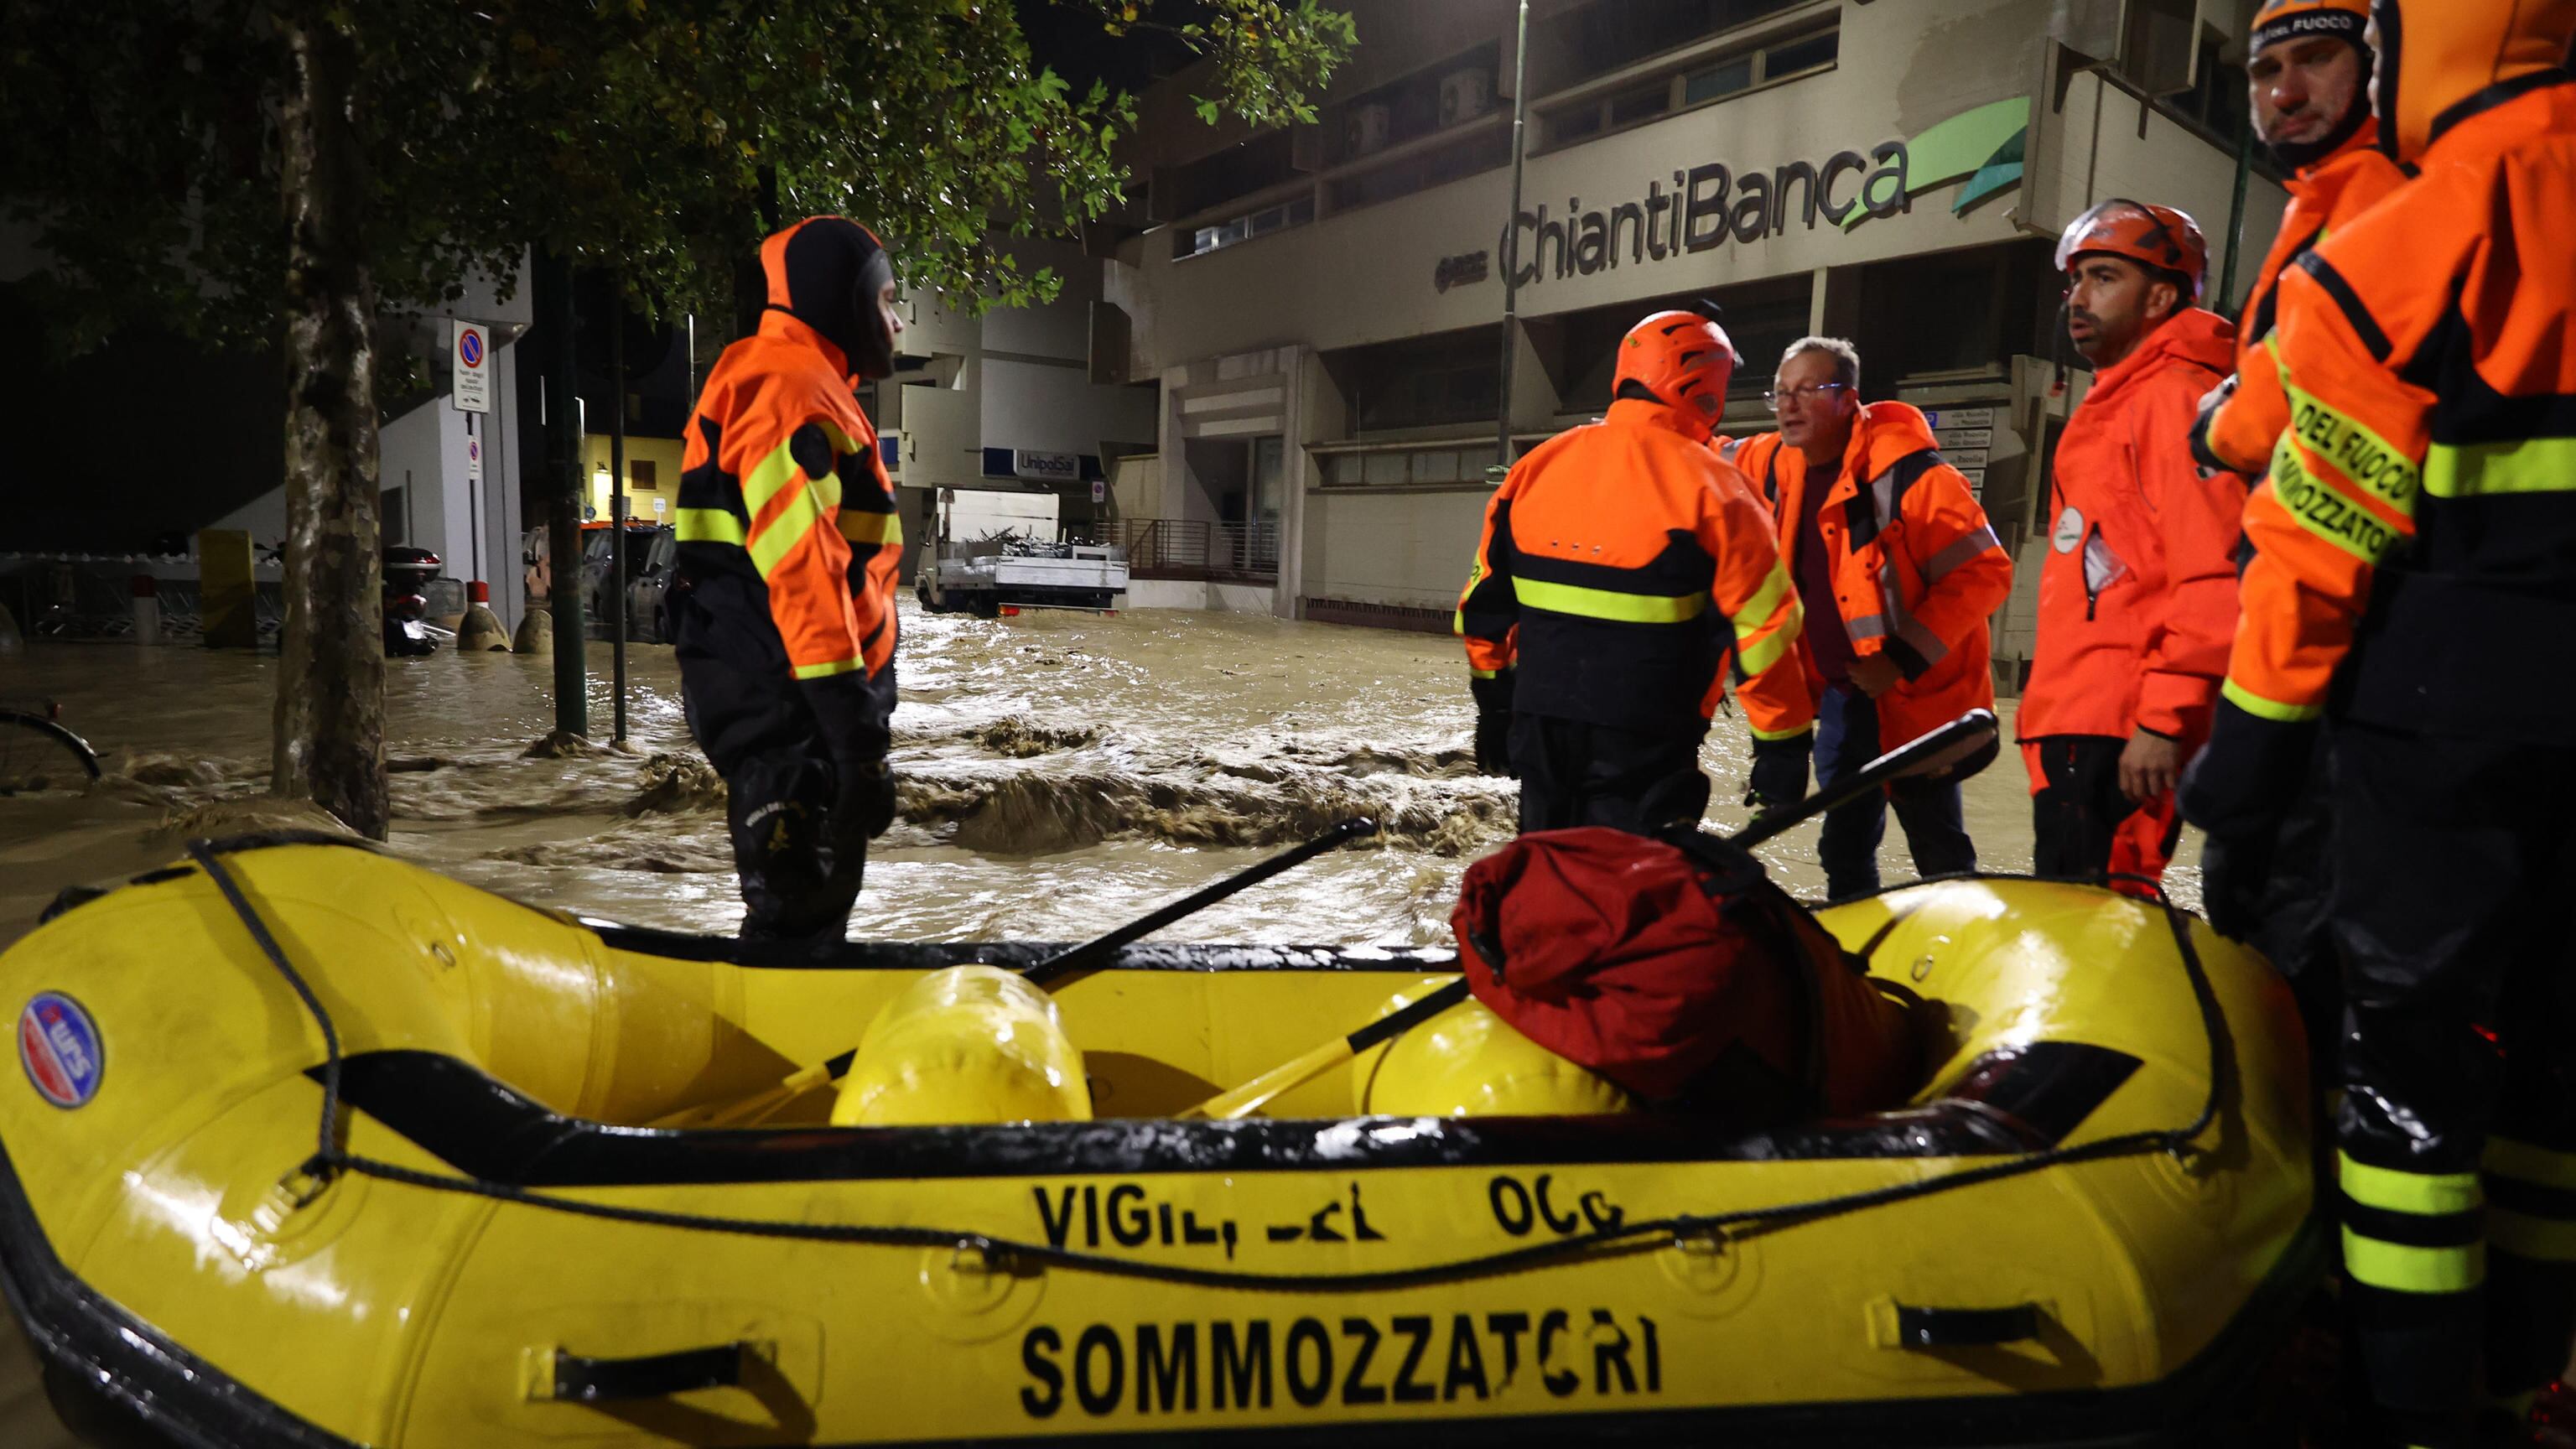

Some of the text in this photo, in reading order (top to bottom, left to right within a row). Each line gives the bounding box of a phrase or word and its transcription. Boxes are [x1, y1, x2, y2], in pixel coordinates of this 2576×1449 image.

[2293, 16, 2351, 32] FUOCO
[1499, 140, 1912, 290] ChiantiBanca
[2295, 403, 2417, 500] DEL FUOCO
[1020, 1308, 1662, 1419] SOMMOZZATORI
